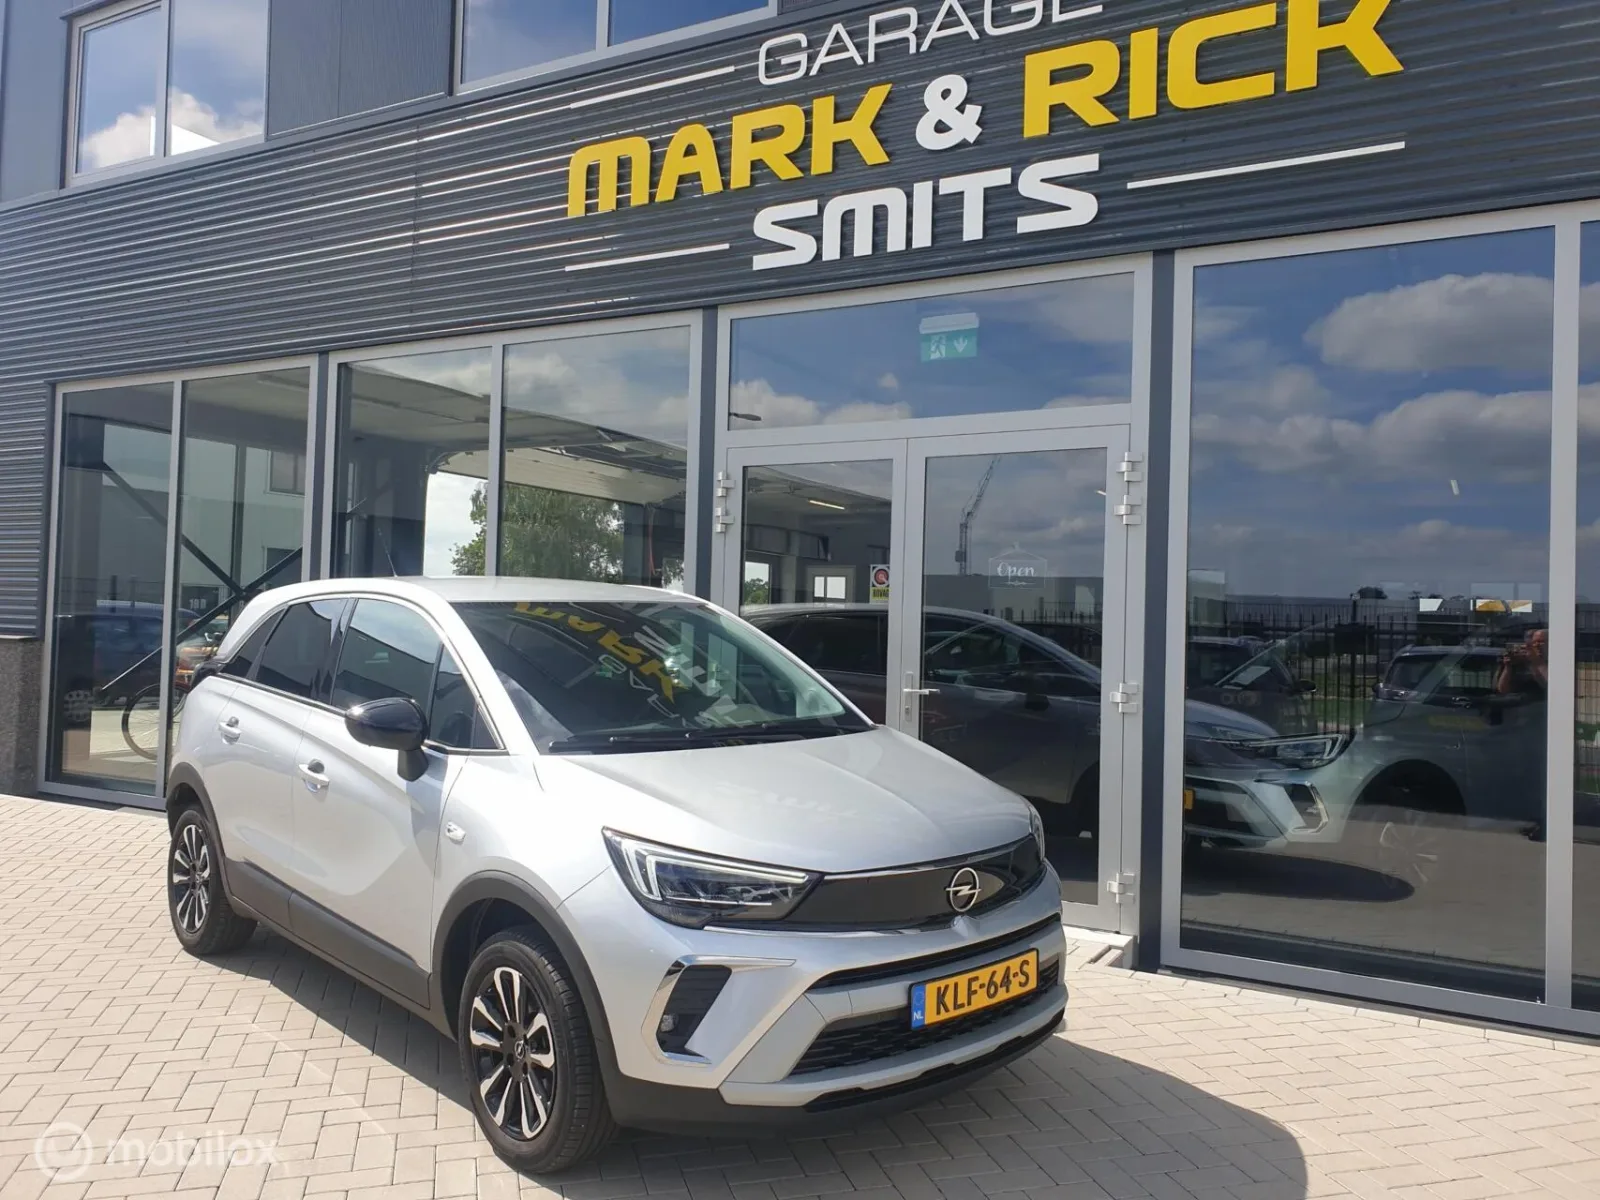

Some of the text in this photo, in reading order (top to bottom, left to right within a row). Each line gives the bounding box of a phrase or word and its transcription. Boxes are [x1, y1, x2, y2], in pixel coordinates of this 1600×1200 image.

[566, 0, 1404, 217] MARK & RICK
[752, 154, 1099, 271] SMITS
[996, 560, 1035, 584] Open
[913, 1010, 924, 1021] NL
[935, 959, 1030, 1016] KLF-64-S
